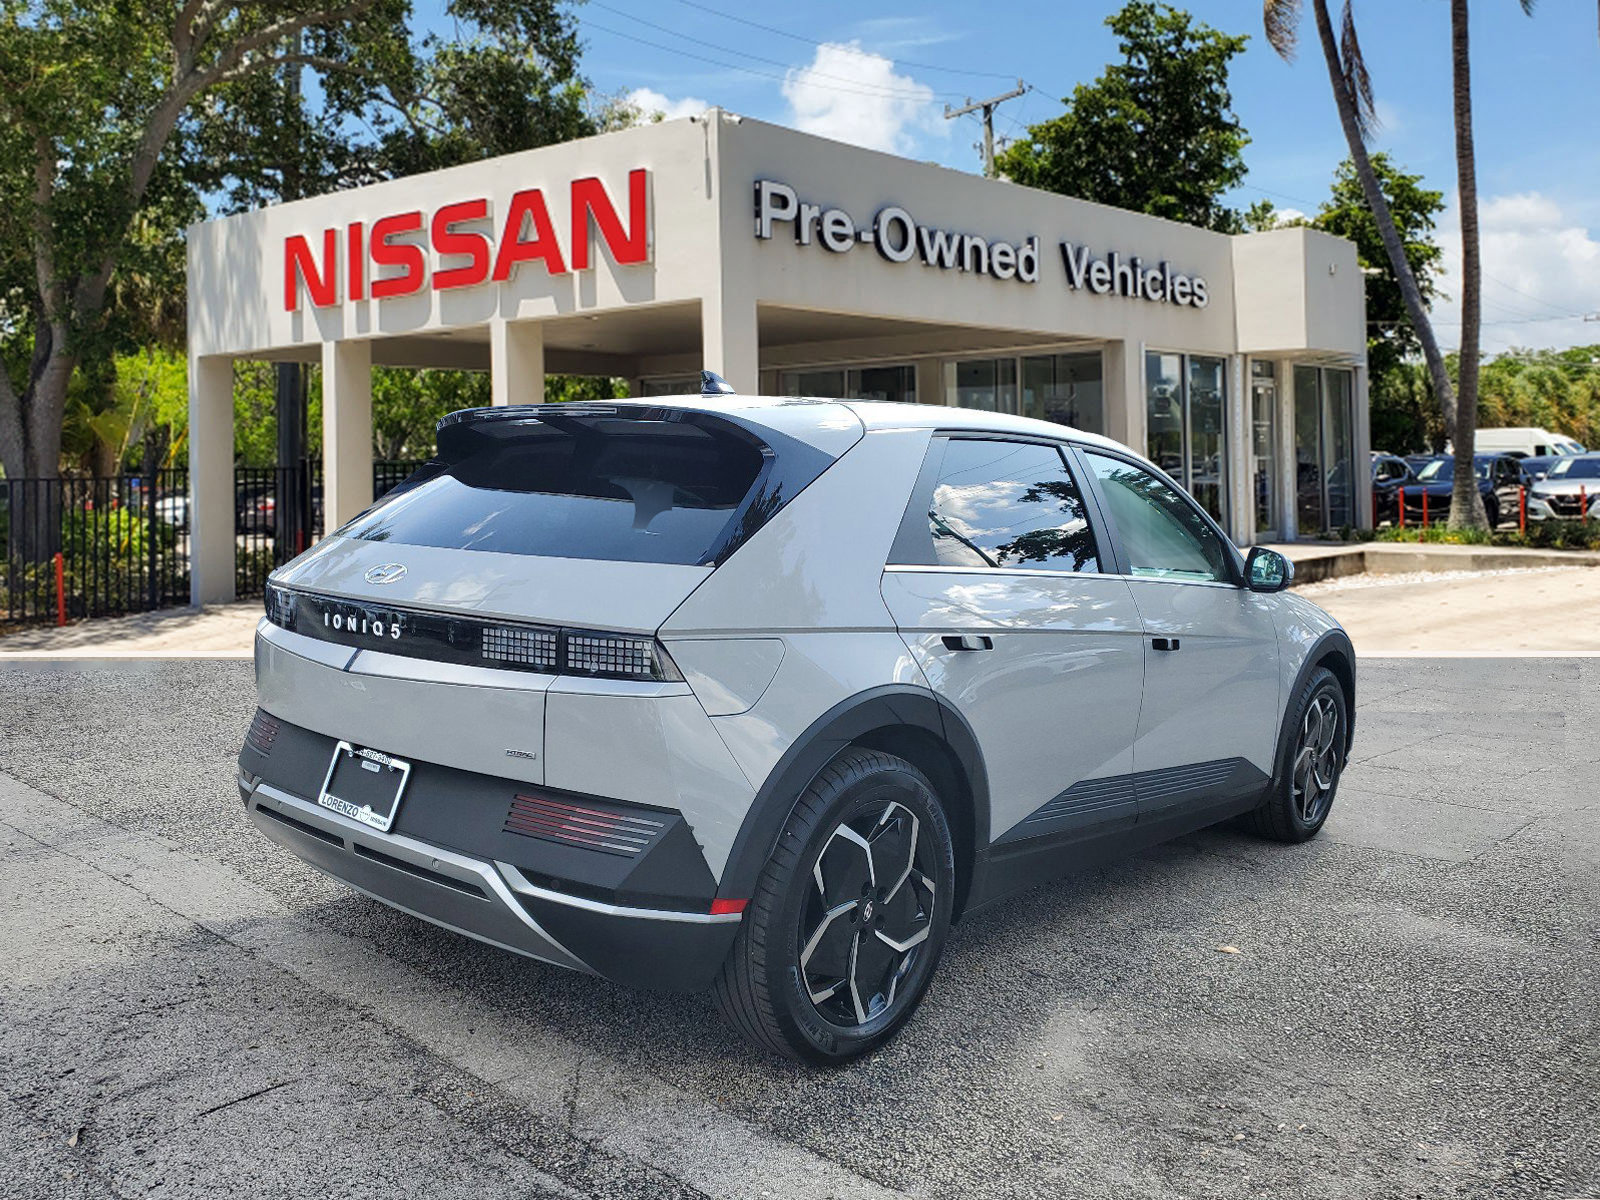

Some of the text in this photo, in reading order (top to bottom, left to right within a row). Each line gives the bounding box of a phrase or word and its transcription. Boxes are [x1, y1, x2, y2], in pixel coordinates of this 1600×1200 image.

[284, 168, 649, 312] NISSAN
[754, 179, 1209, 309] Pre-Owned Vehicles
[324, 612, 401, 640] IONIQ 5
[321, 794, 359, 818] LORENZO
